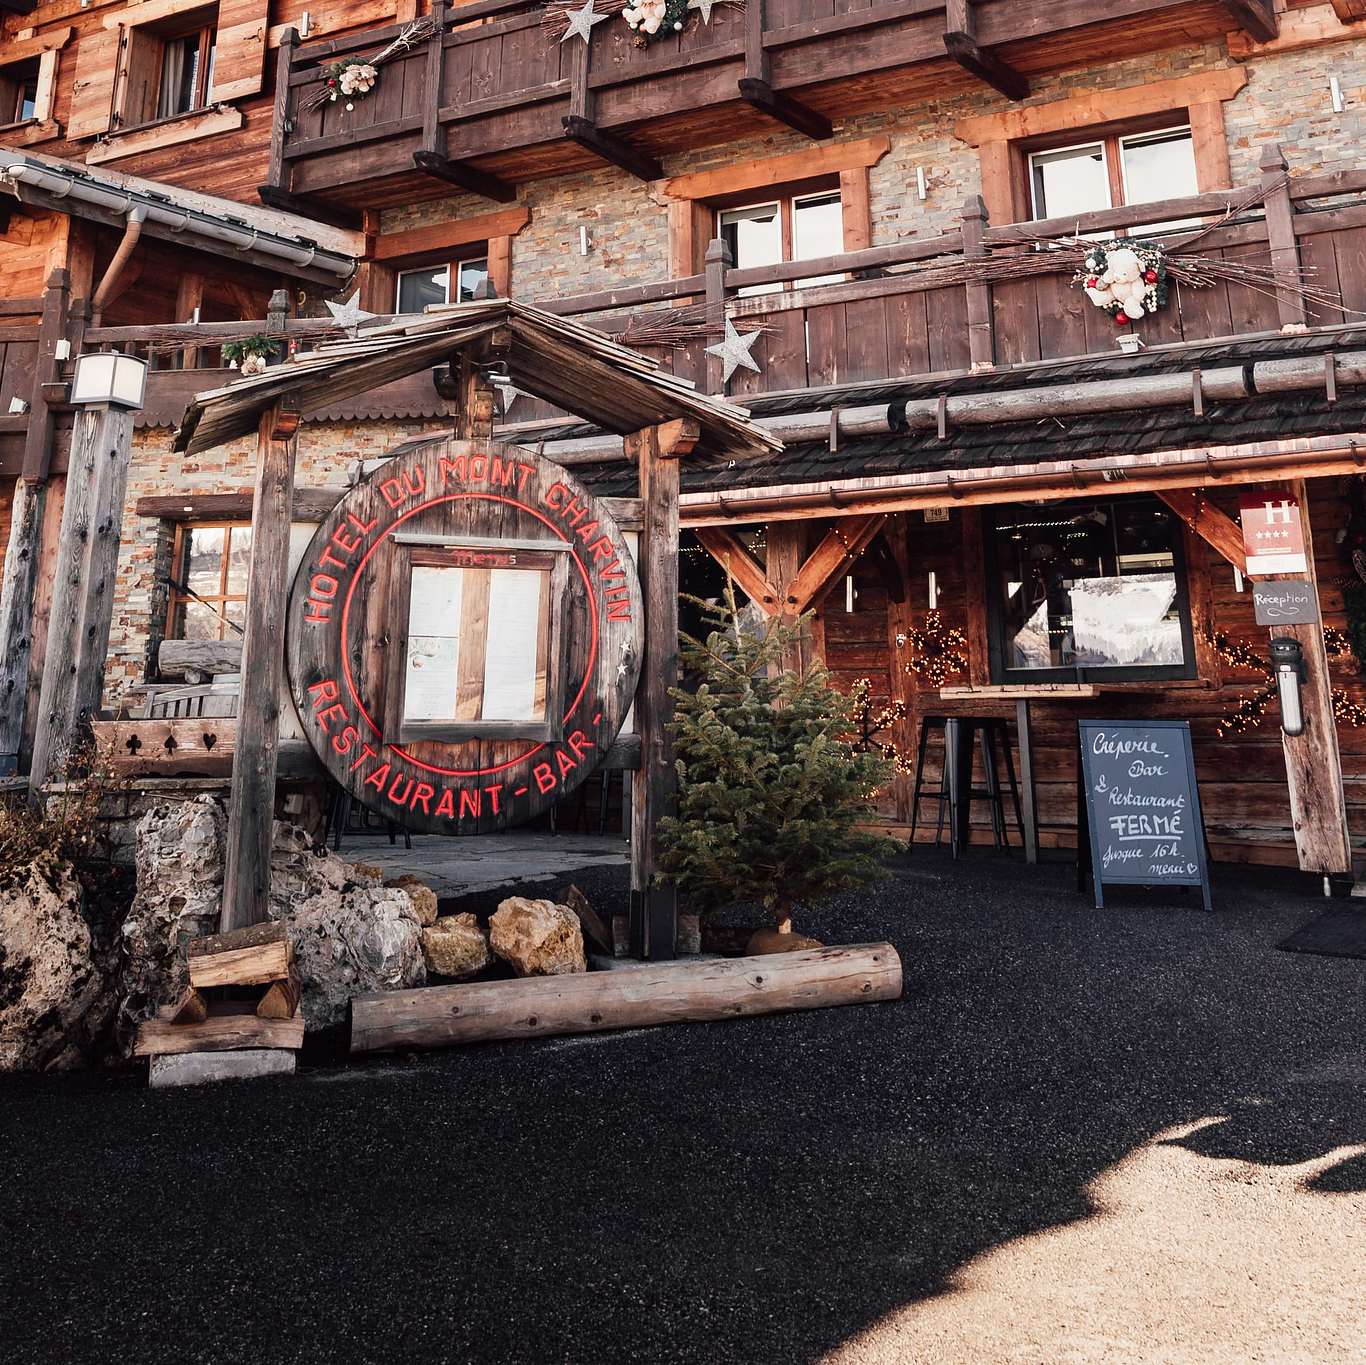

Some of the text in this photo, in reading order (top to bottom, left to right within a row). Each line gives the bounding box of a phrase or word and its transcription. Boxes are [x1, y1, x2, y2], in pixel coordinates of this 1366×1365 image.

[1263, 500, 1294, 525] H
[304, 513, 379, 623] HOTEL
[379, 465, 425, 509] DU
[439, 455, 537, 491] MONT
[544, 483, 632, 622] CHARVIN
[451, 549, 517, 565] Menus
[308, 680, 503, 818] RESTAURANT
[533, 729, 595, 794] BAR
[1128, 760, 1169, 778] Bar
[1108, 786, 1185, 808] Restaurant
[1108, 809, 1184, 835] FERMÉ
[1148, 861, 1185, 876] merci
